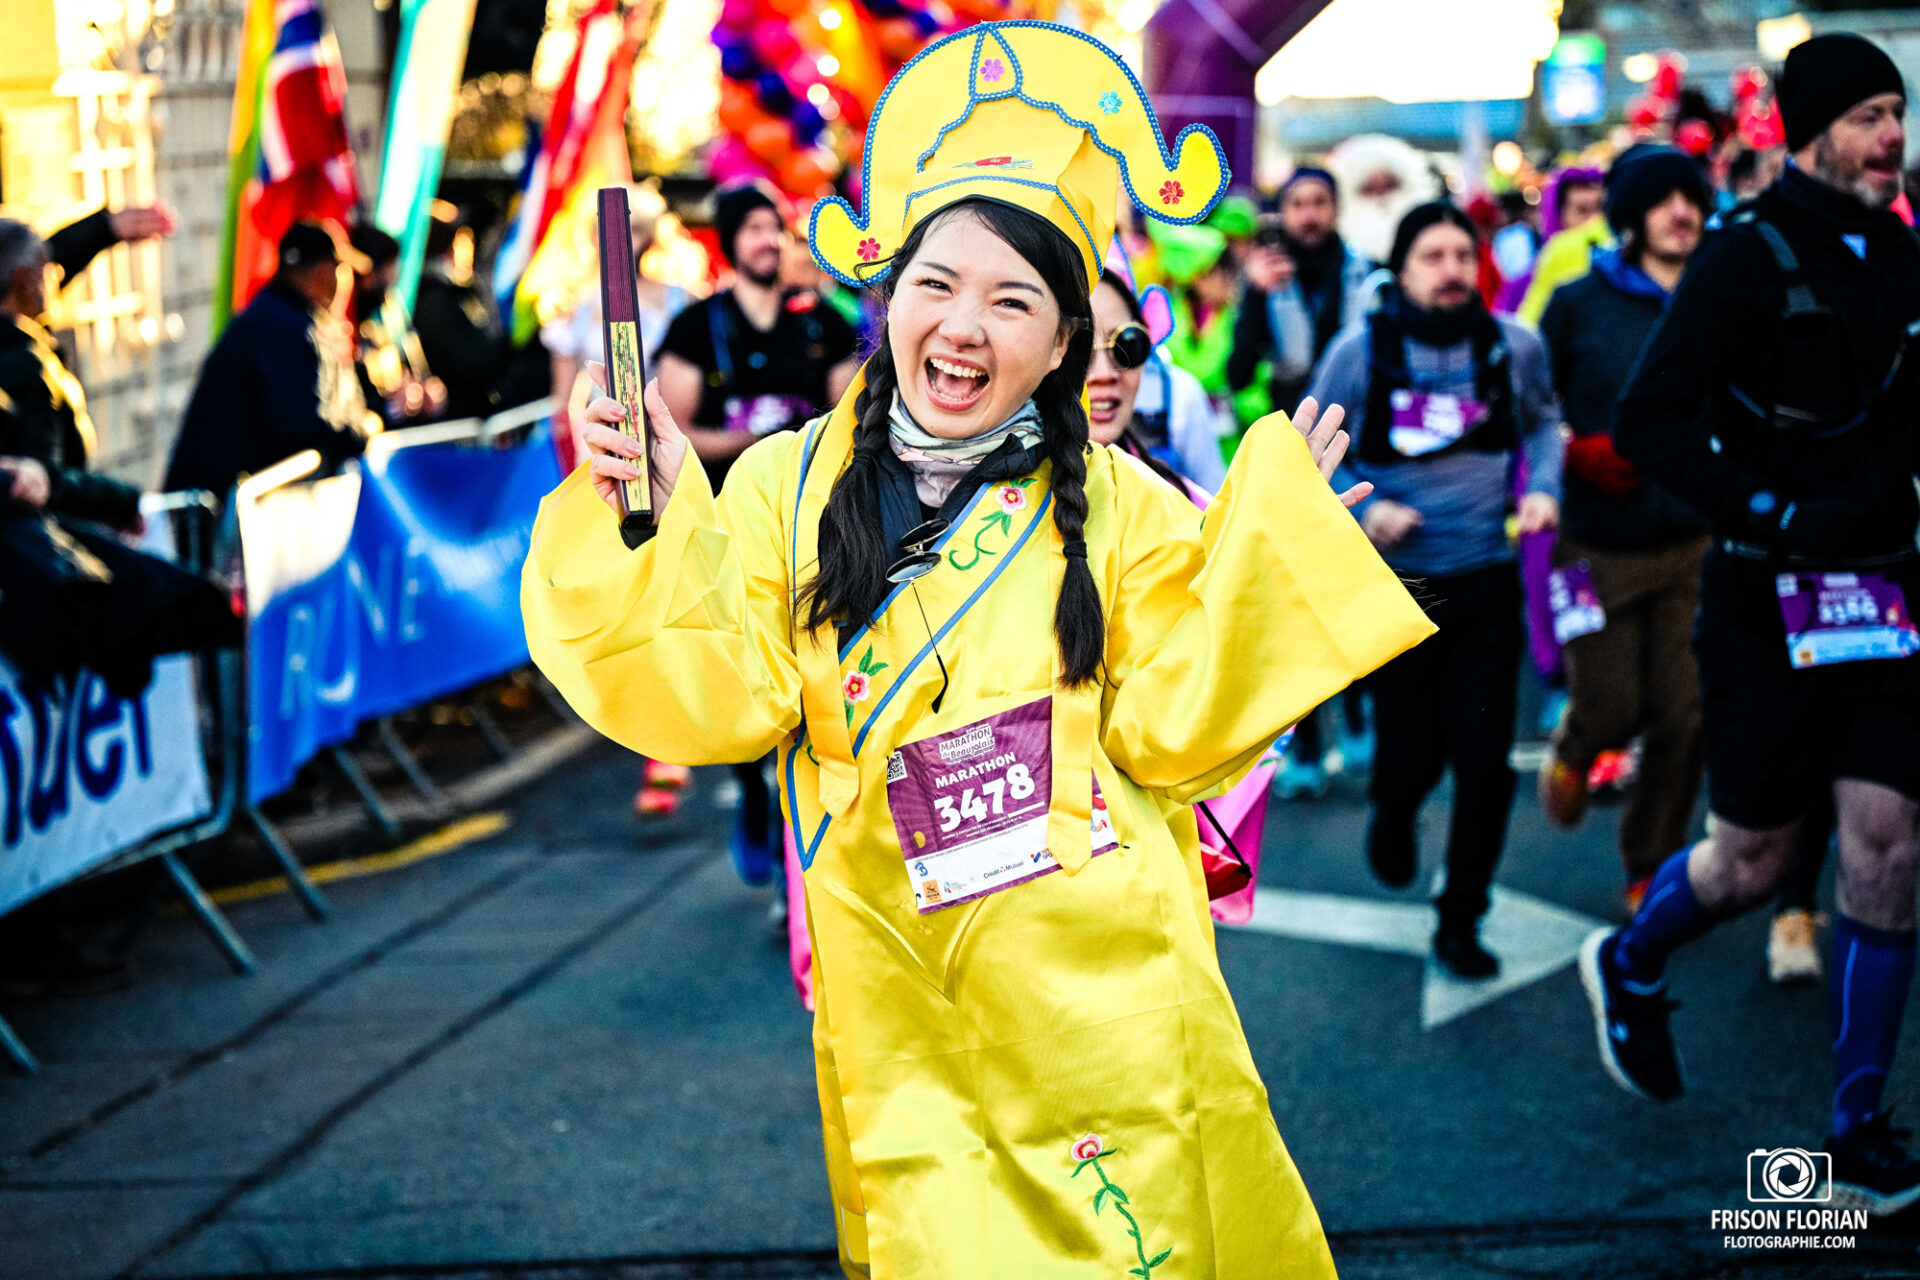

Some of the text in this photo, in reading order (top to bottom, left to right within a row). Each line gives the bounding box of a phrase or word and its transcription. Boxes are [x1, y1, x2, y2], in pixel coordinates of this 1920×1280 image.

[940, 727, 992, 752] MARATHON
[950, 738, 995, 760] Beaujolais
[935, 751, 1016, 789] MARATHON
[933, 763, 1035, 832] 3478
